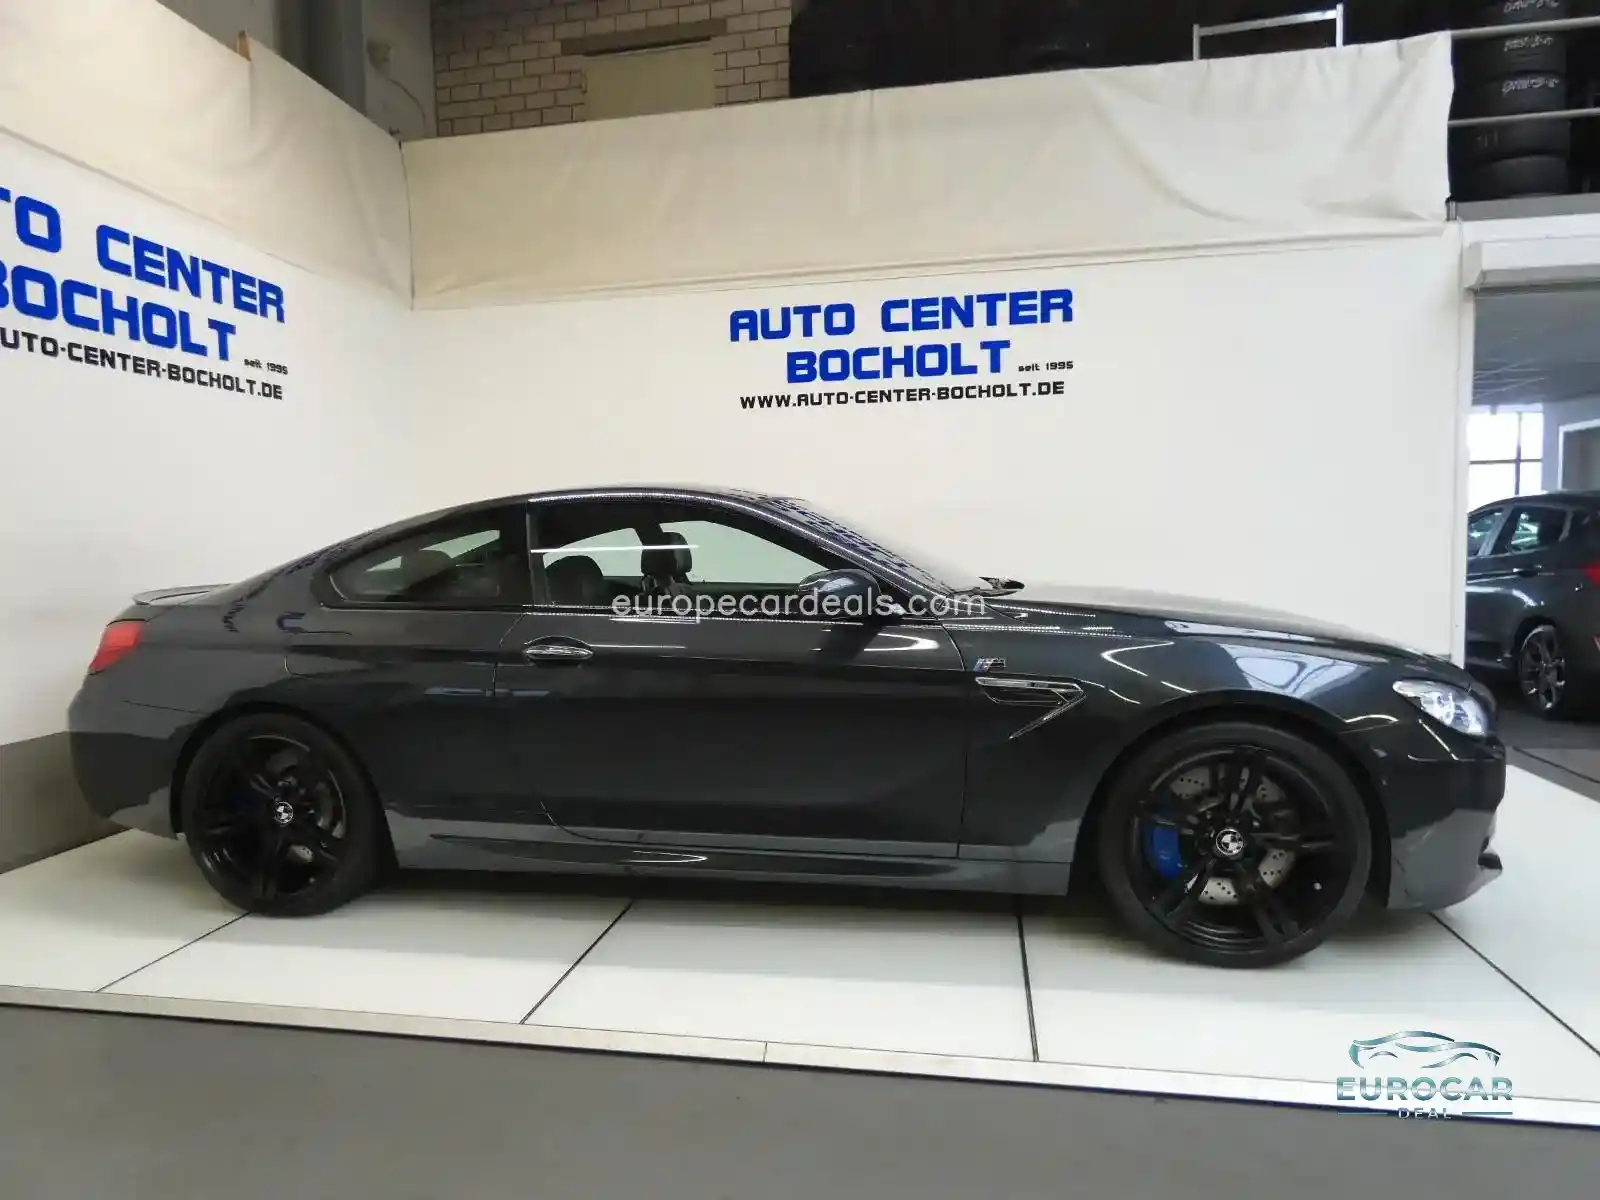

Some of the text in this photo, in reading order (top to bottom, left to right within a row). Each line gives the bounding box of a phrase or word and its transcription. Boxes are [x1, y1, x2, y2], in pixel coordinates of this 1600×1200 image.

[0, 187, 285, 323] O CENTER
[0, 260, 236, 361] OCHOLT
[266, 362, 289, 375] 1995
[729, 288, 1073, 342] AUTO CENTER
[786, 339, 1074, 384] BOCHOLT seit 1995
